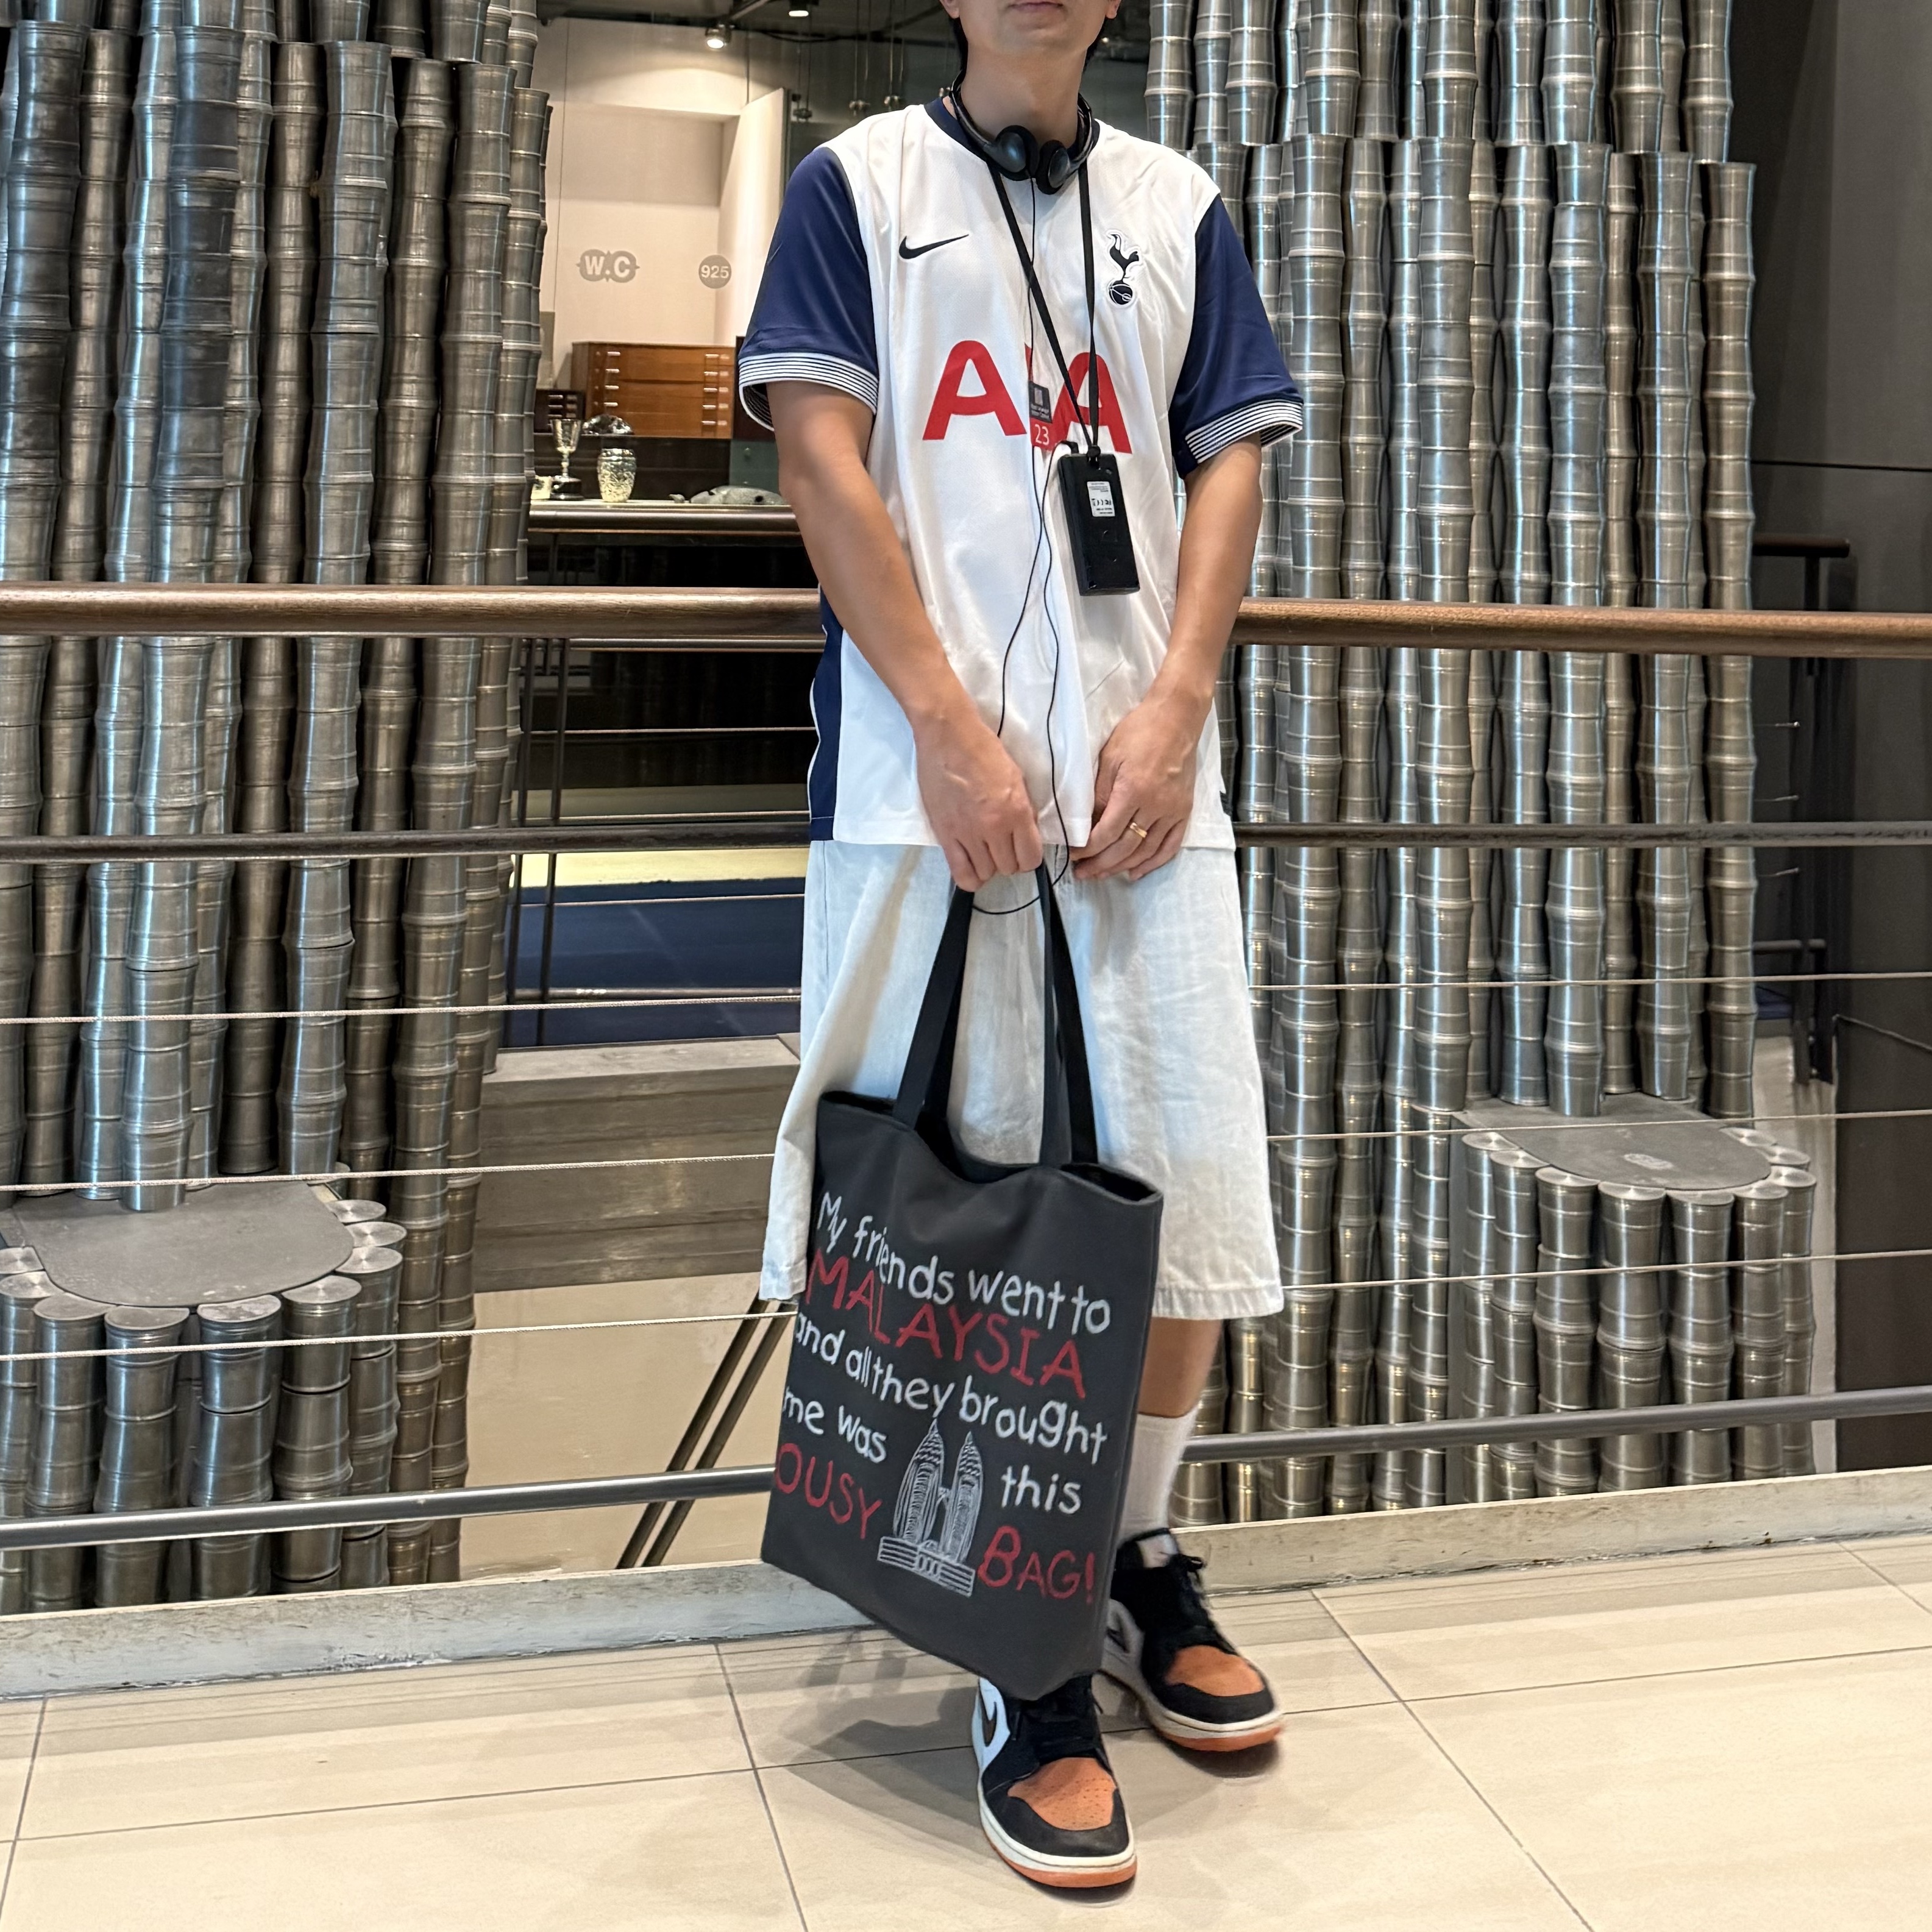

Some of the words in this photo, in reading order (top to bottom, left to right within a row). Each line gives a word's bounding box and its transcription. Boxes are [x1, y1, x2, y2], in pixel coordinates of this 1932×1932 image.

[701, 265, 729, 279] 925
[922, 339, 1132, 455] AA
[1035, 424, 1049, 446] 23
[805, 1248, 1086, 1399] MALAYSIA
[817, 1192, 847, 1253] My
[853, 1215, 954, 1305] friends
[968, 1269, 1065, 1330] went
[1071, 1285, 1110, 1335] to
[783, 1386, 824, 1435] me
[838, 1405, 887, 1463] was
[1001, 1464, 1081, 1515] this
[845, 1346, 872, 1388] all
[872, 1355, 955, 1418] they
[959, 1375, 1107, 1465] brought
[775, 1443, 883, 1540] OUSY
[977, 1525, 1095, 1605] BAG!
